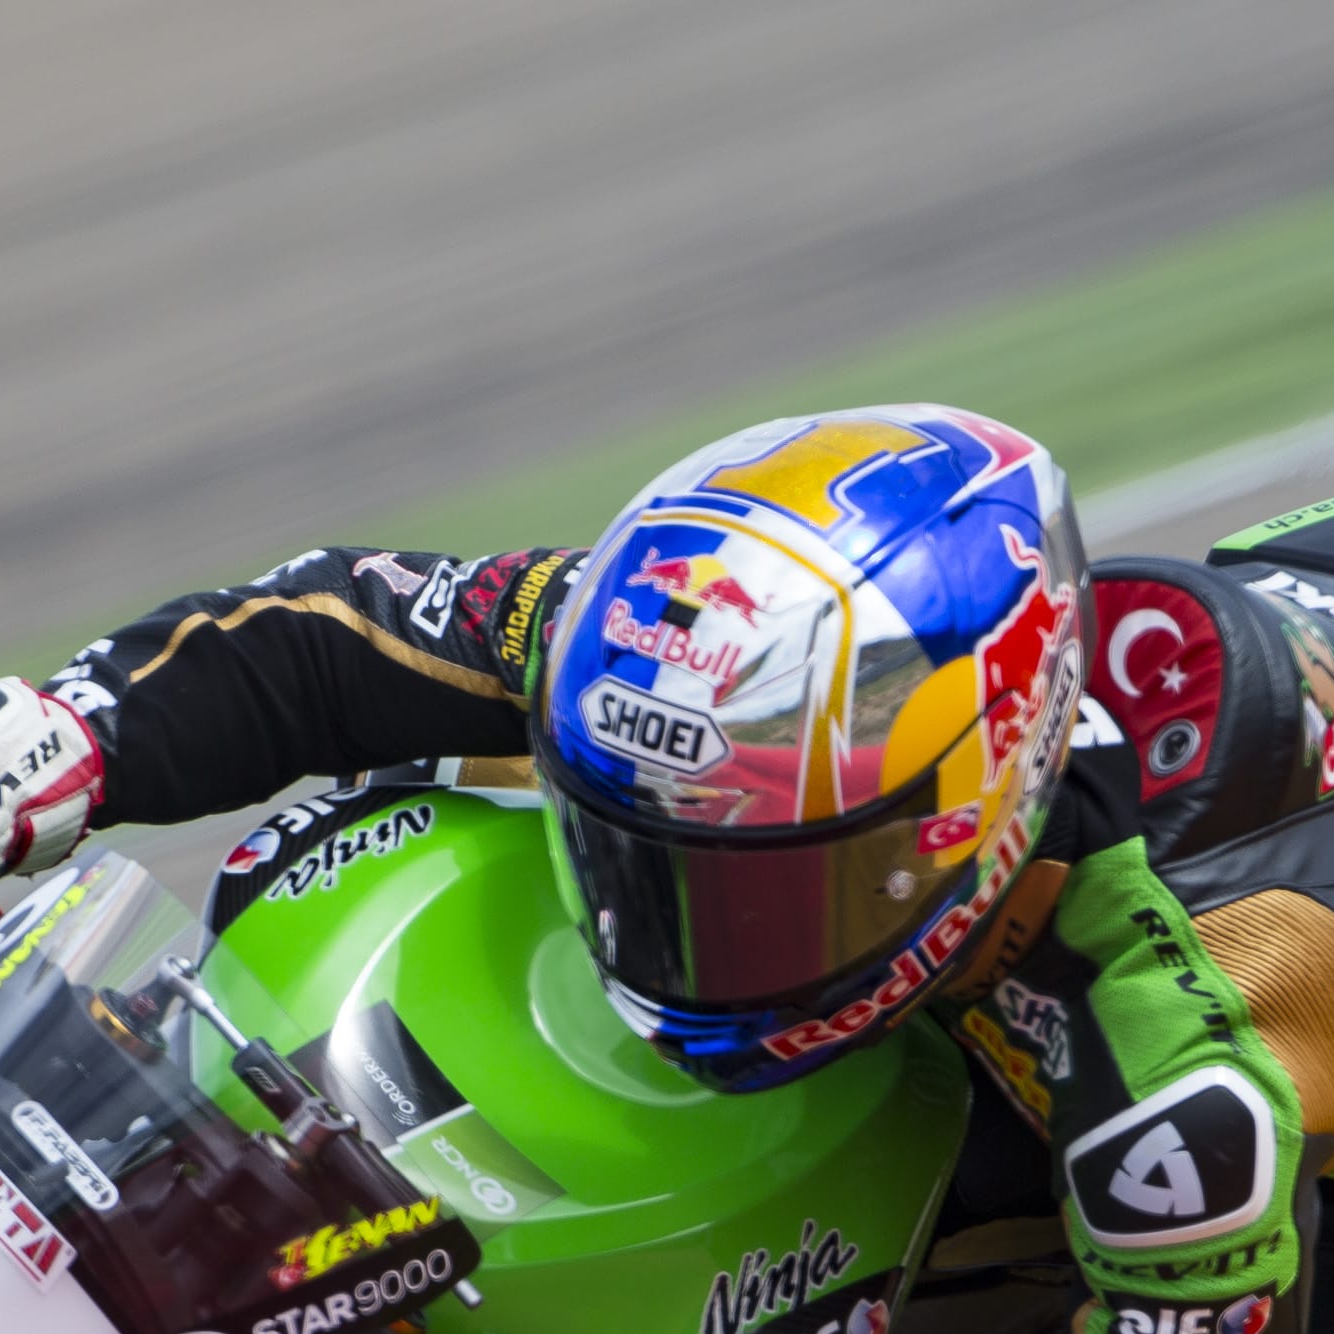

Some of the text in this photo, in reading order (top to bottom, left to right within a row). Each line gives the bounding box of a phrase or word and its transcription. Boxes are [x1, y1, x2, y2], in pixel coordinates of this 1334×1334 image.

[602, 598, 743, 693] Red Bull
[598, 694, 703, 765] SHOEI
[269, 803, 432, 900] Ninja
[764, 950, 929, 1061] Red
[920, 818, 1033, 968] Bull
[432, 1136, 476, 1181] NCR
